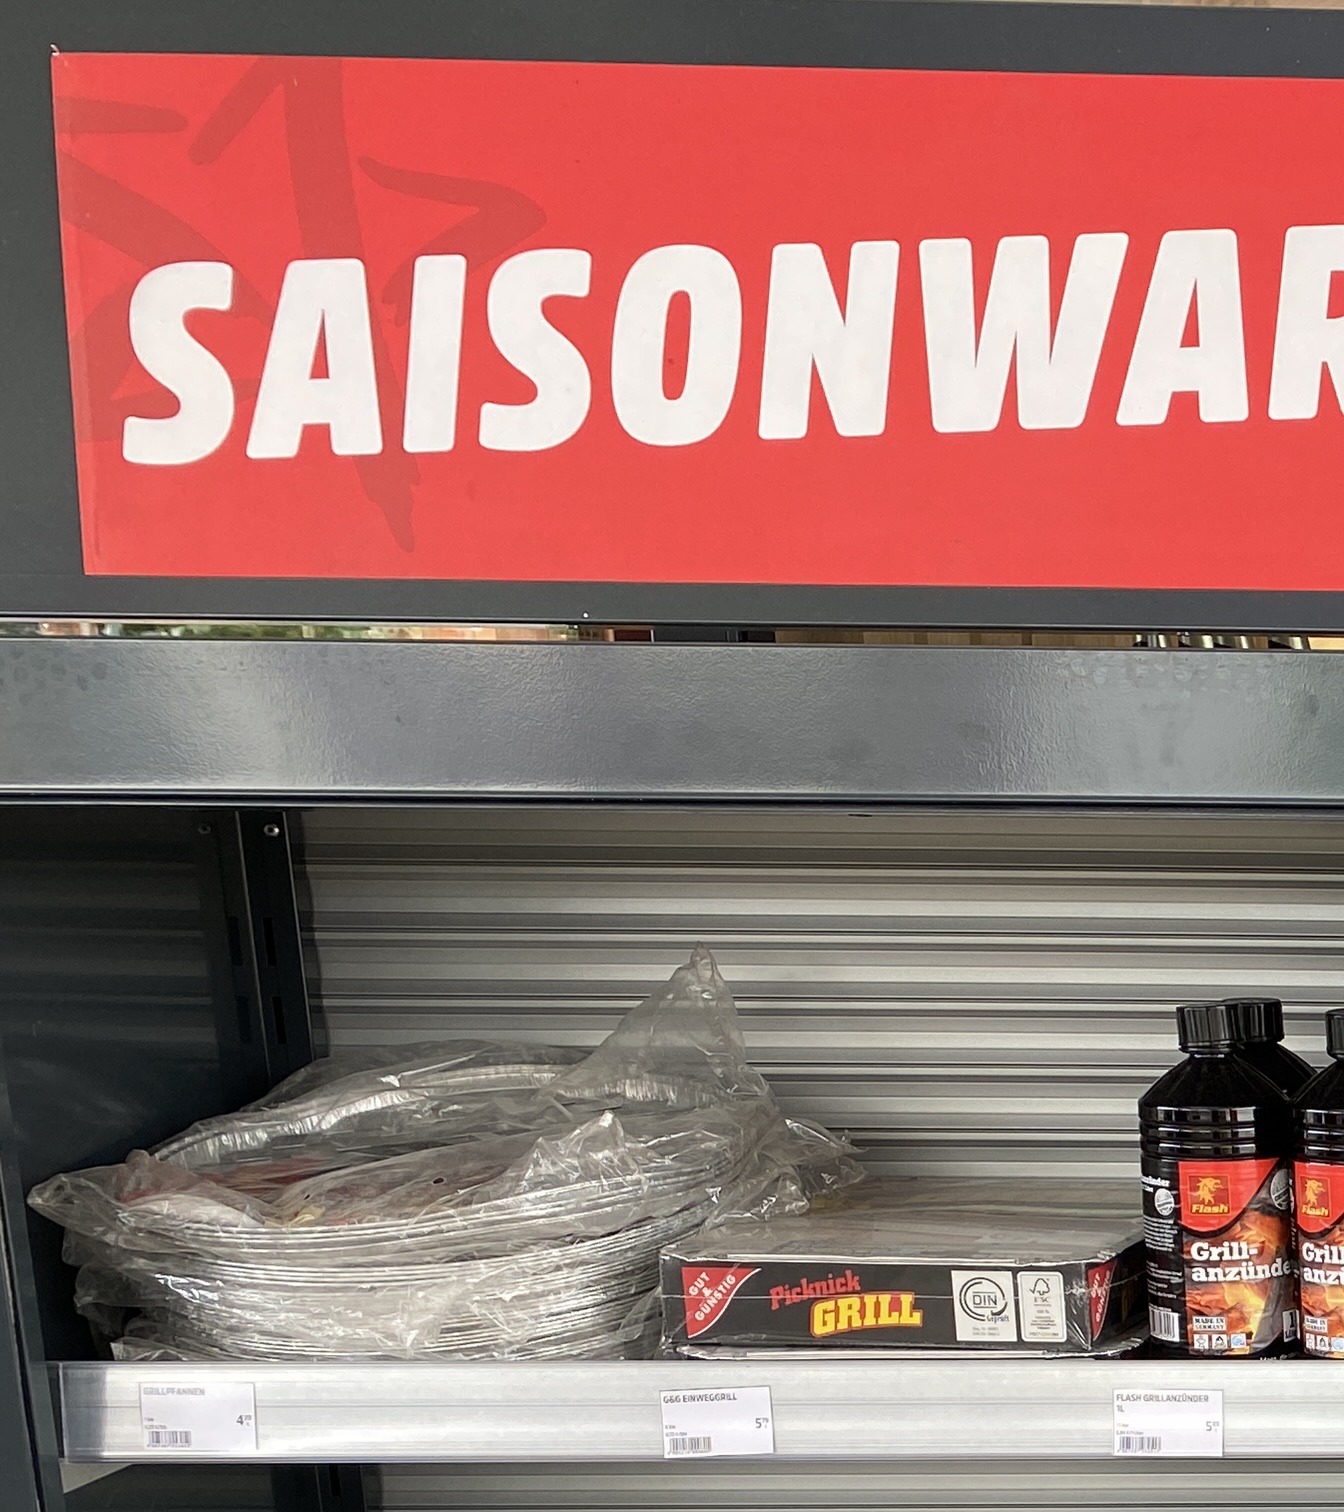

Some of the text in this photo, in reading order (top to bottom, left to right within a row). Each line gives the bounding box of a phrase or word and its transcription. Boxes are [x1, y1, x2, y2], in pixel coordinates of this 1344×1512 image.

[1191, 1204, 1229, 1214] Flash
[1301, 1205, 1330, 1218] Flash
[1190, 1241, 1258, 1261] Grill-
[1191, 1258, 1291, 1283] anzünde
[689, 1272, 711, 1296] GUT
[702, 1287, 712, 1296] &
[769, 1269, 861, 1311] Picknick
[694, 1274, 737, 1321] GÜNSTIG
[972, 1295, 997, 1306] DIN
[811, 1292, 922, 1338] GRILL
[683, 1393, 737, 1403] EINWEGGRILL
[1143, 1393, 1209, 1402] GRILLANZÜNDER
